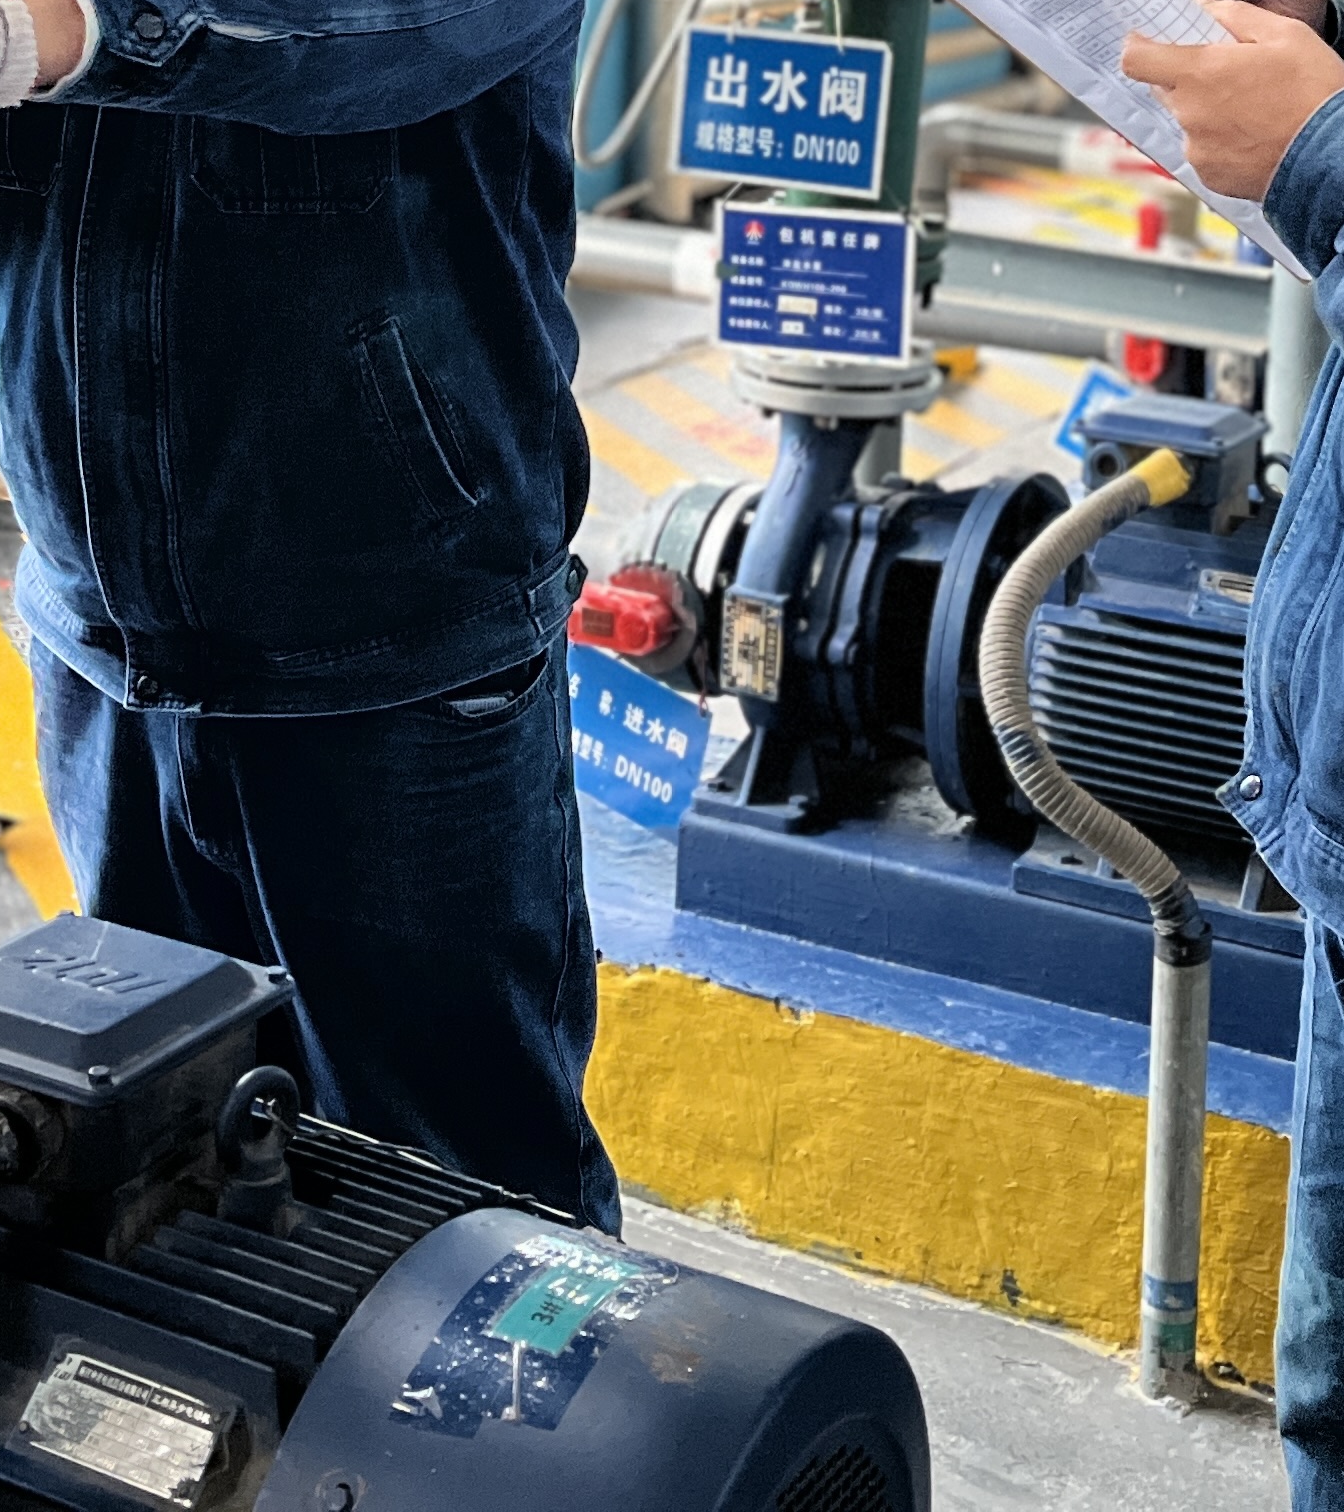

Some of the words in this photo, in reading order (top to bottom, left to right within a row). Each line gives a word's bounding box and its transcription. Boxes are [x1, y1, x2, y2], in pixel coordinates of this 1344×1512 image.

[704, 54, 867, 122] 出水阀
[778, 227, 880, 251] 包机责任牌
